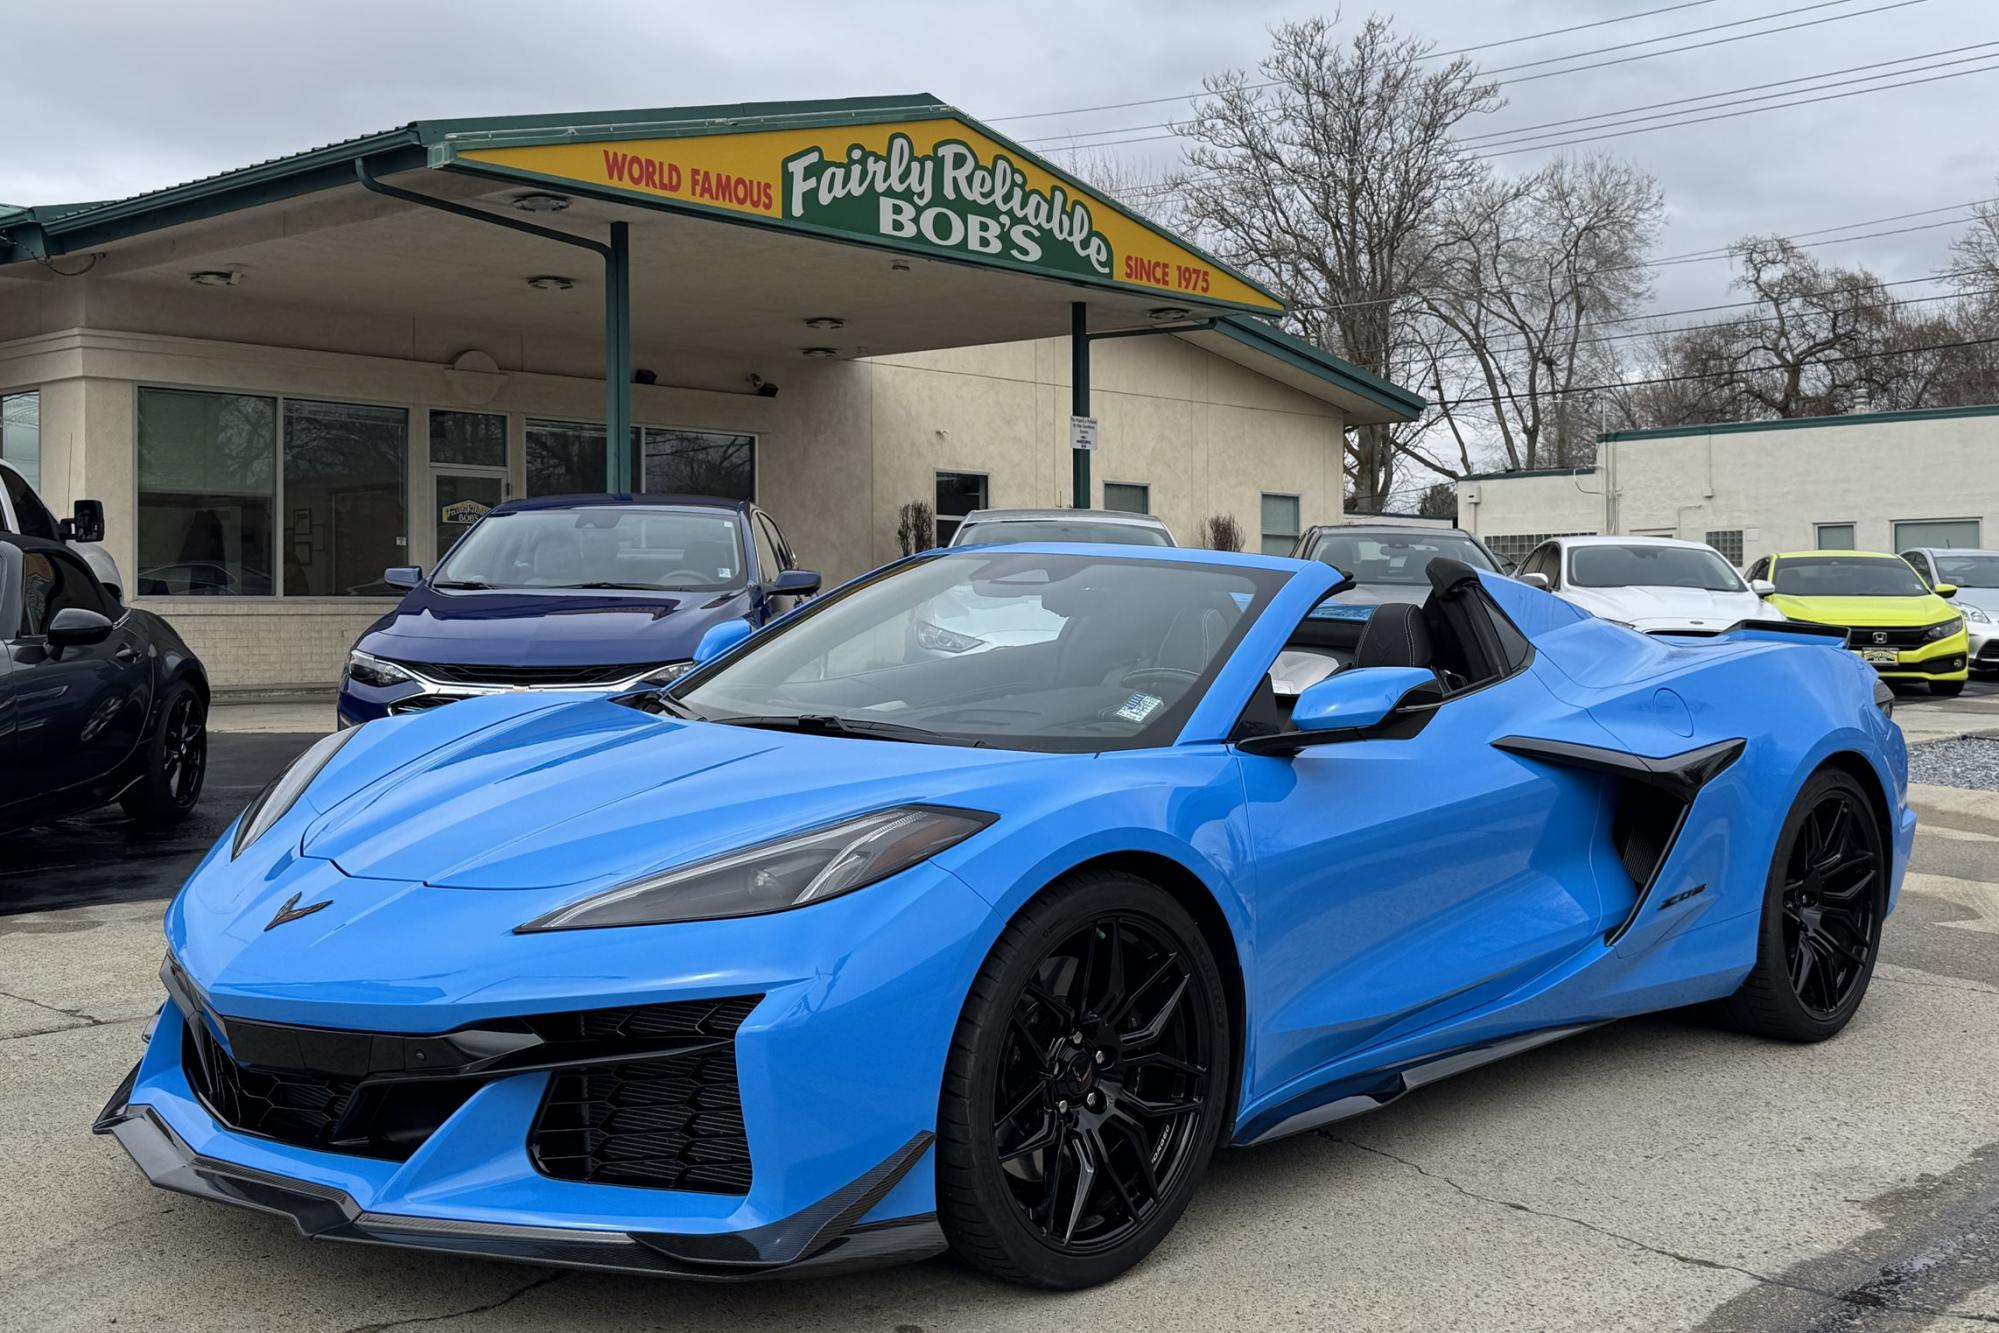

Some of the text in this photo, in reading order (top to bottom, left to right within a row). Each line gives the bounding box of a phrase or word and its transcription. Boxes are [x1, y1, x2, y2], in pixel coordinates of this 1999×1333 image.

[603, 149, 773, 211] WORLD FAMOUS
[787, 137, 1110, 274] Fairly Reliable
[879, 196, 1043, 263] BOB'S
[1125, 254, 1210, 293] SINCE 1975
